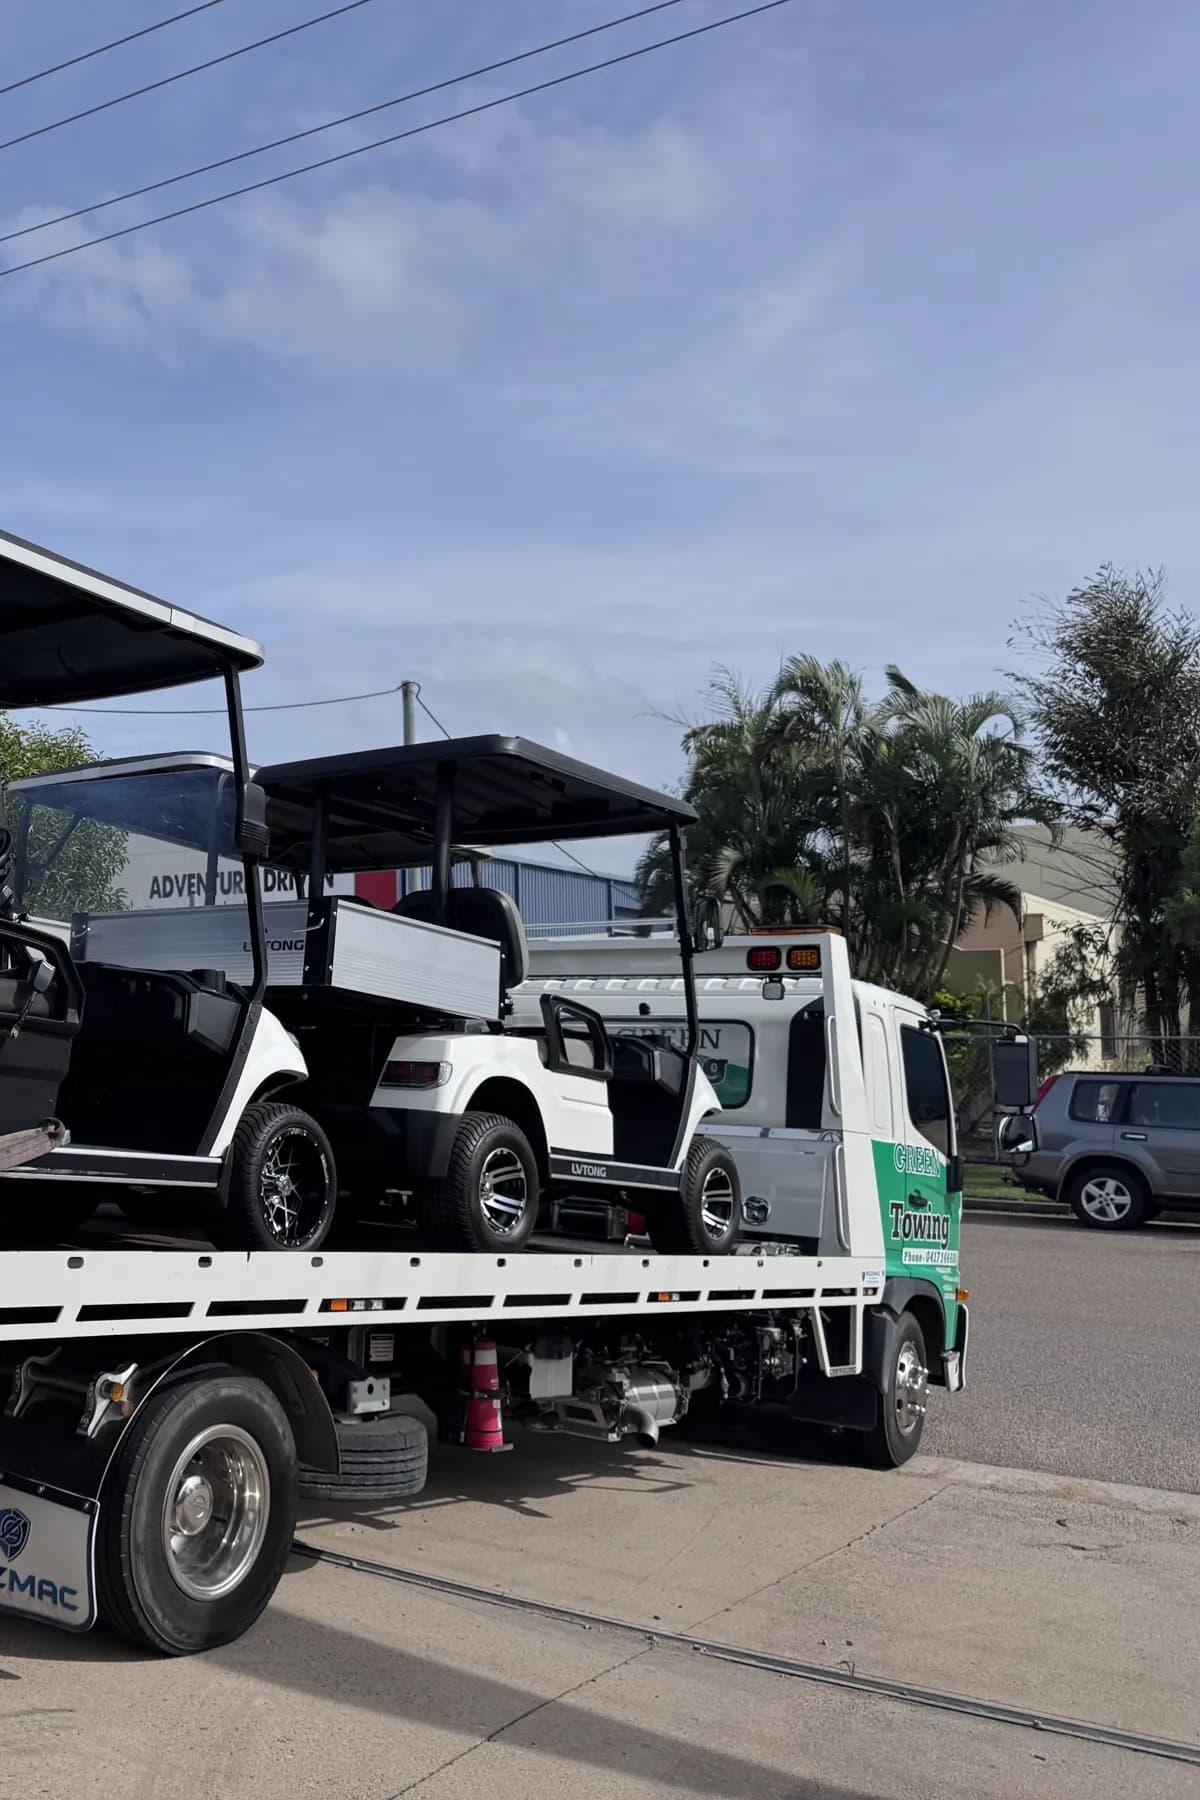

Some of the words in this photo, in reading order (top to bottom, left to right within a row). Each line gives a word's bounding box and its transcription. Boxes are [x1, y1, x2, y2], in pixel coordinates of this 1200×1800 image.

[149, 869, 248, 900] ADVENUR
[571, 1162, 607, 1178] LVTONG
[894, 1143, 941, 1178] GREEN
[889, 1201, 950, 1250] Towing
